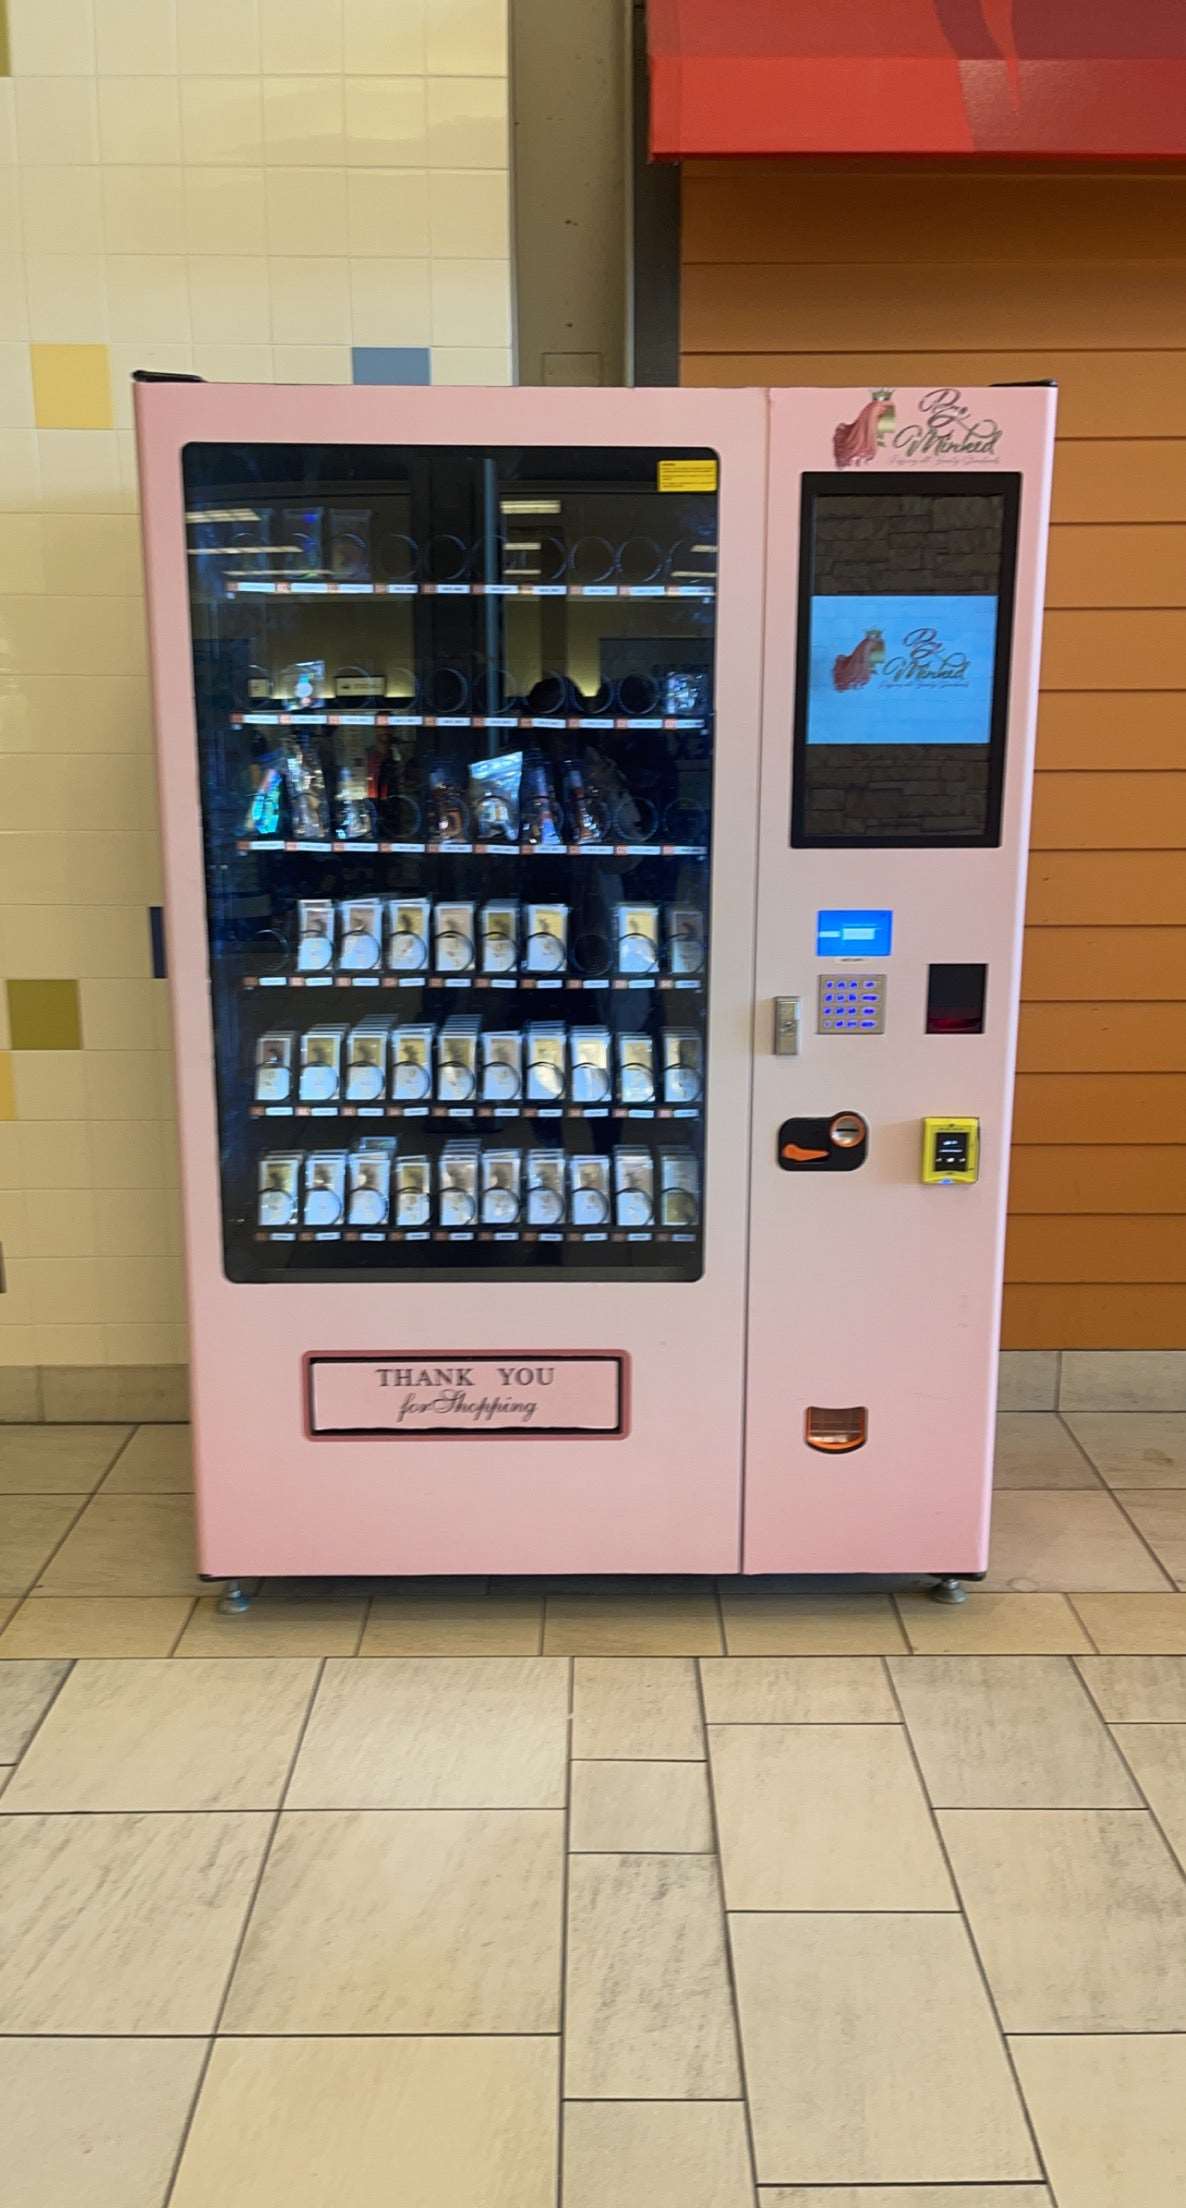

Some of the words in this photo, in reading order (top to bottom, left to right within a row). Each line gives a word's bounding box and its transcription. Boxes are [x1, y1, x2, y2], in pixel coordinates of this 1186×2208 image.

[375, 1368, 475, 1387] THANK
[498, 1367, 555, 1387] YOU
[397, 1392, 433, 1423] for
[431, 1389, 537, 1422] Shopping
